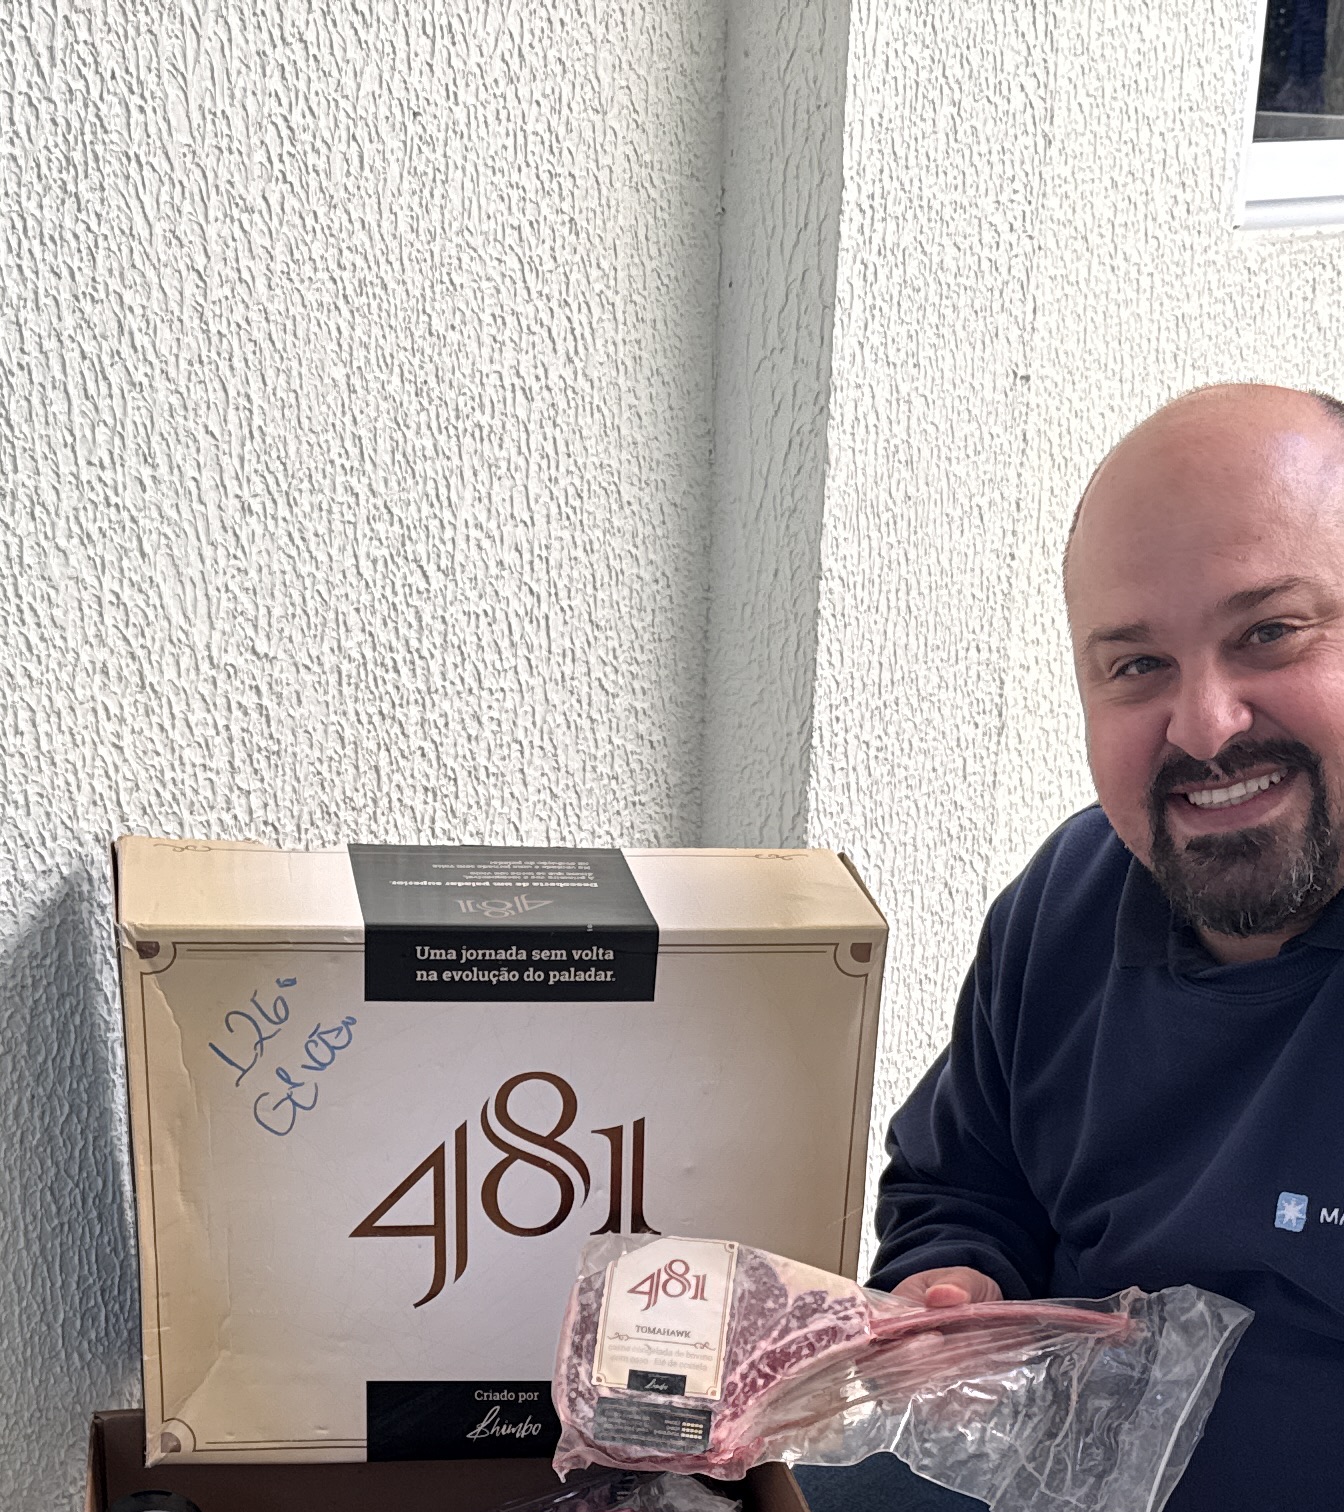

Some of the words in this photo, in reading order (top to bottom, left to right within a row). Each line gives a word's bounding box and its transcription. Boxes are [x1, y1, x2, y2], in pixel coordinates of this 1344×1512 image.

[415, 946, 457, 961] Uma
[460, 945, 527, 963] jornada
[531, 949, 568, 961] sem
[571, 946, 615, 961] volta
[415, 970, 438, 982] na
[442, 966, 520, 985] evolução
[523, 967, 545, 982] do
[547, 967, 616, 985] paladar.
[348, 1071, 662, 1309] 481
[627, 1258, 709, 1312] 481
[635, 1324, 692, 1339] TOMAHAWK
[474, 1389, 516, 1401] Criado
[518, 1391, 540, 1403] por
